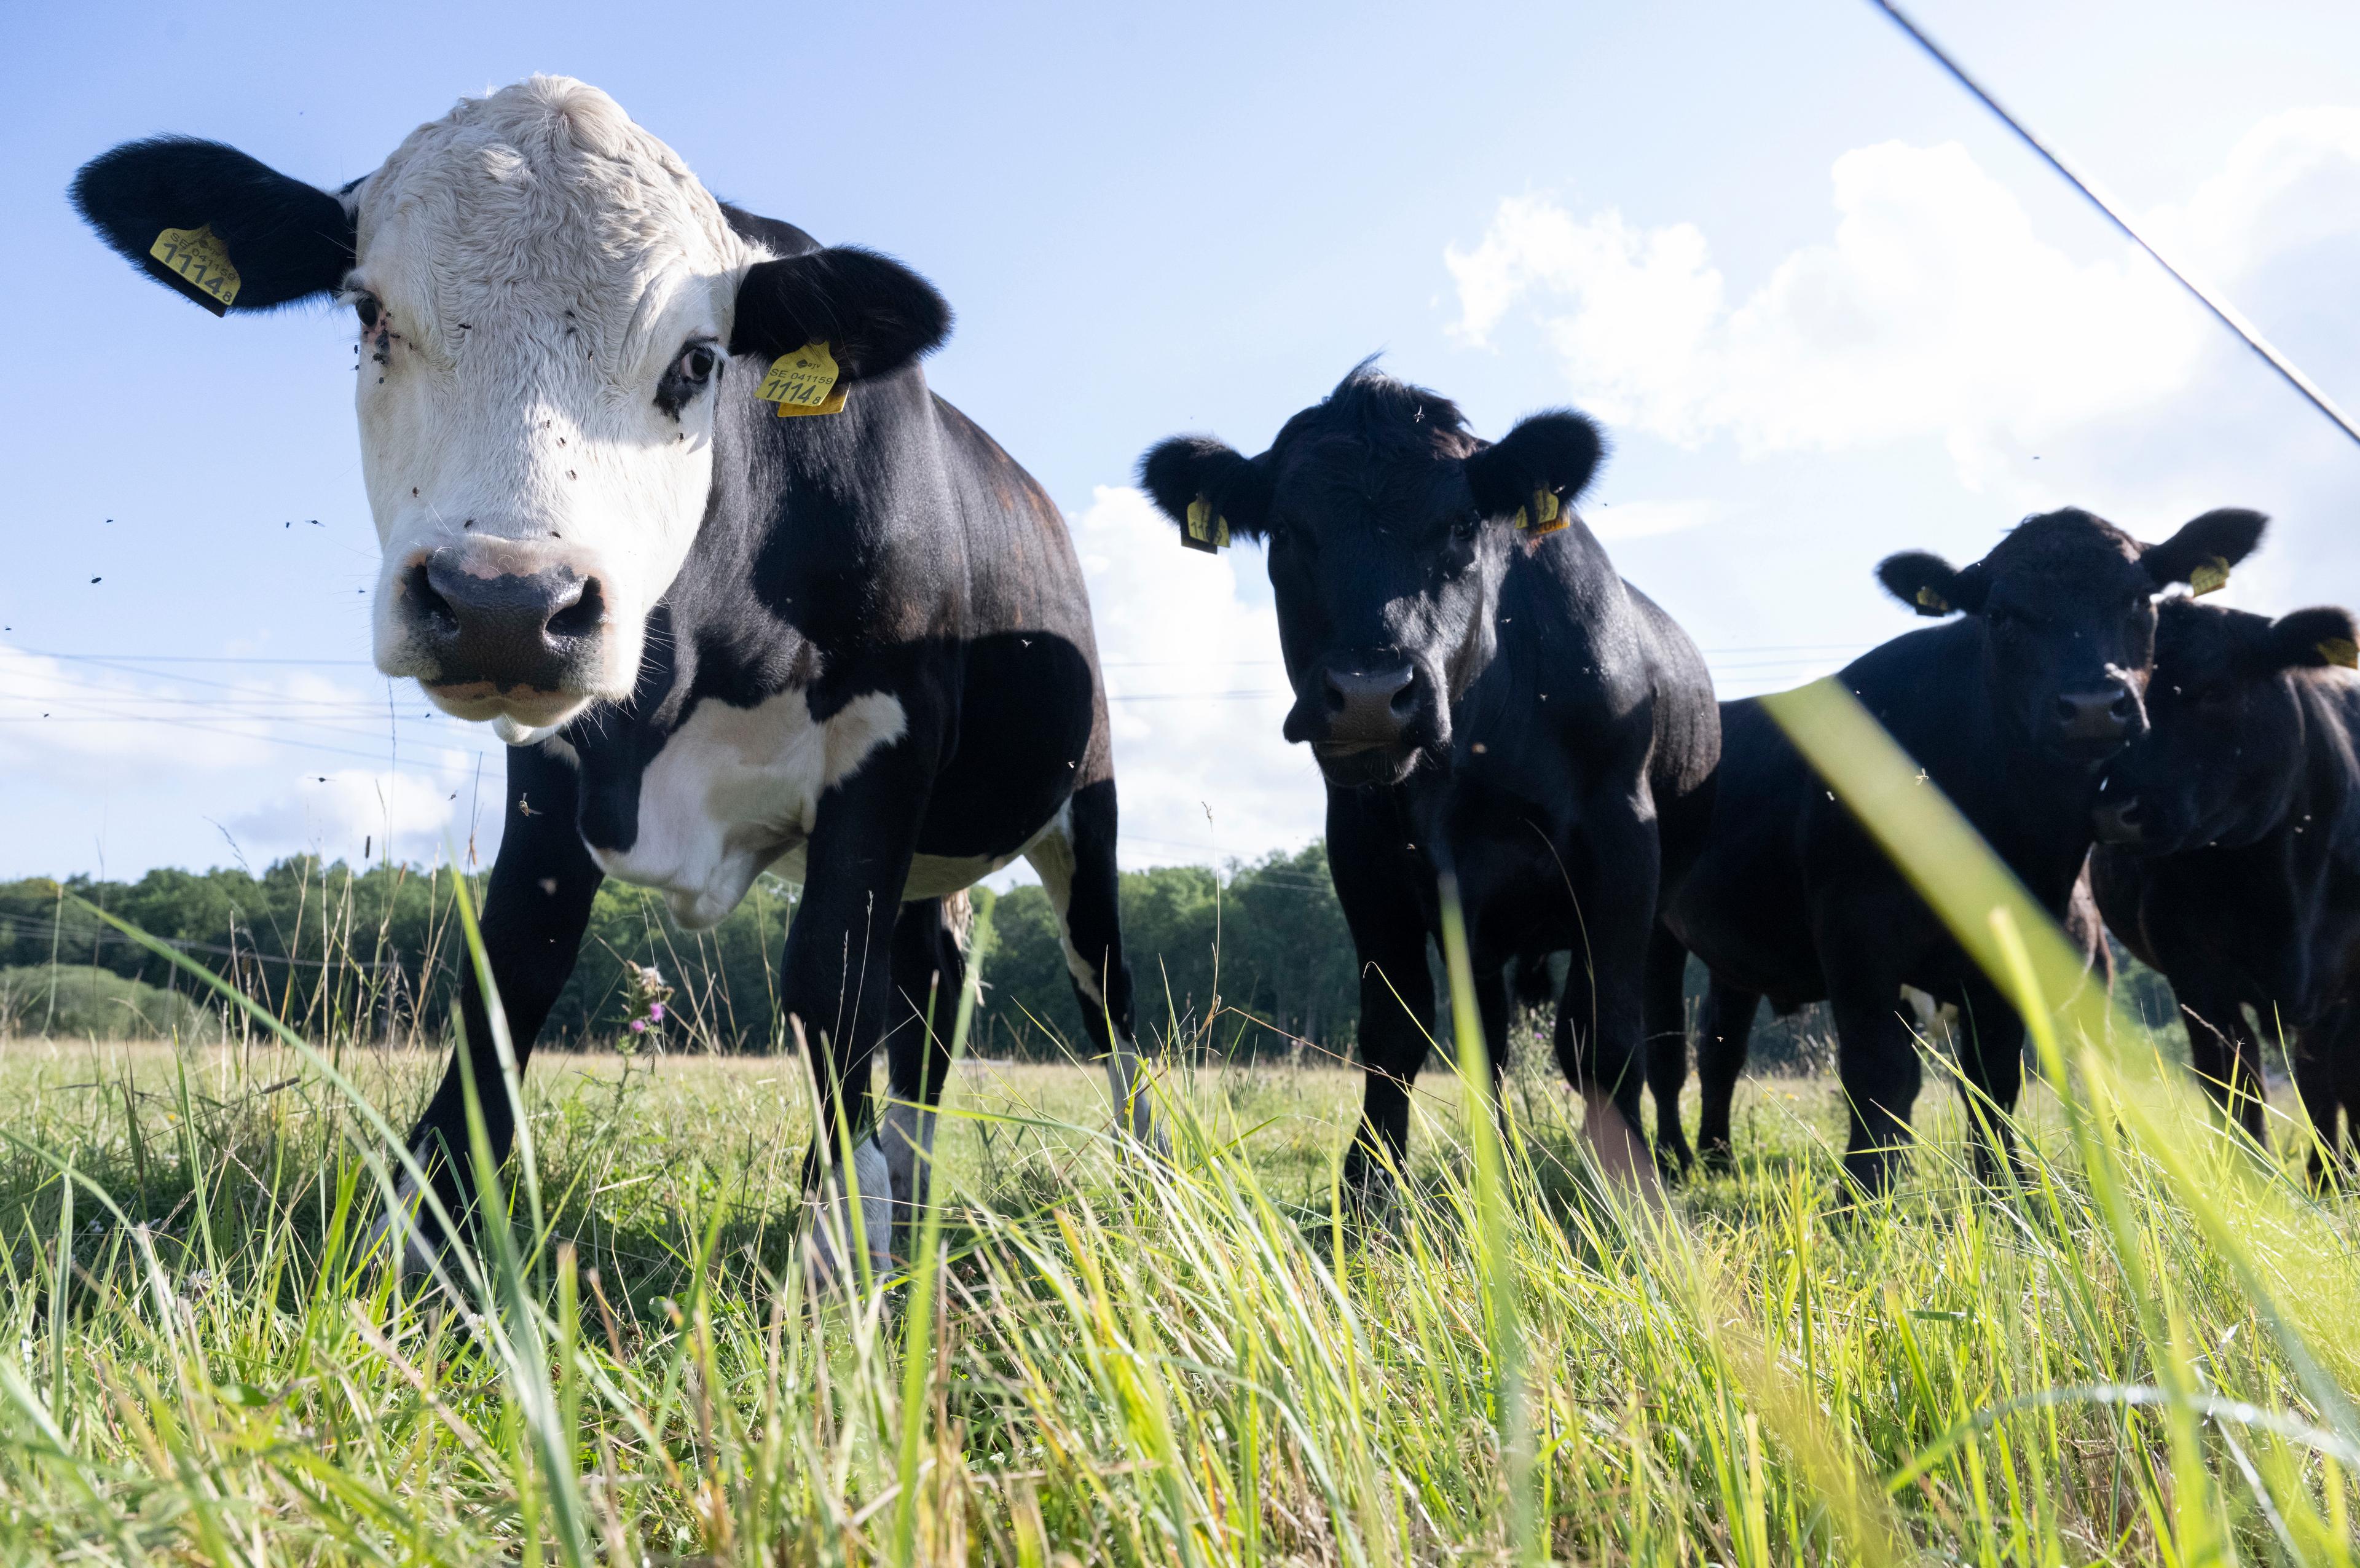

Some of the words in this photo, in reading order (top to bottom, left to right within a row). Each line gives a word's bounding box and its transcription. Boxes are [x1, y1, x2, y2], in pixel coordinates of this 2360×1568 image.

[170, 232, 189, 250] SE
[163, 243, 224, 295] 1114
[222, 291, 232, 302] 8
[769, 369, 788, 378] SE
[791, 372, 833, 385] 041159
[767, 379, 816, 403] 1114
